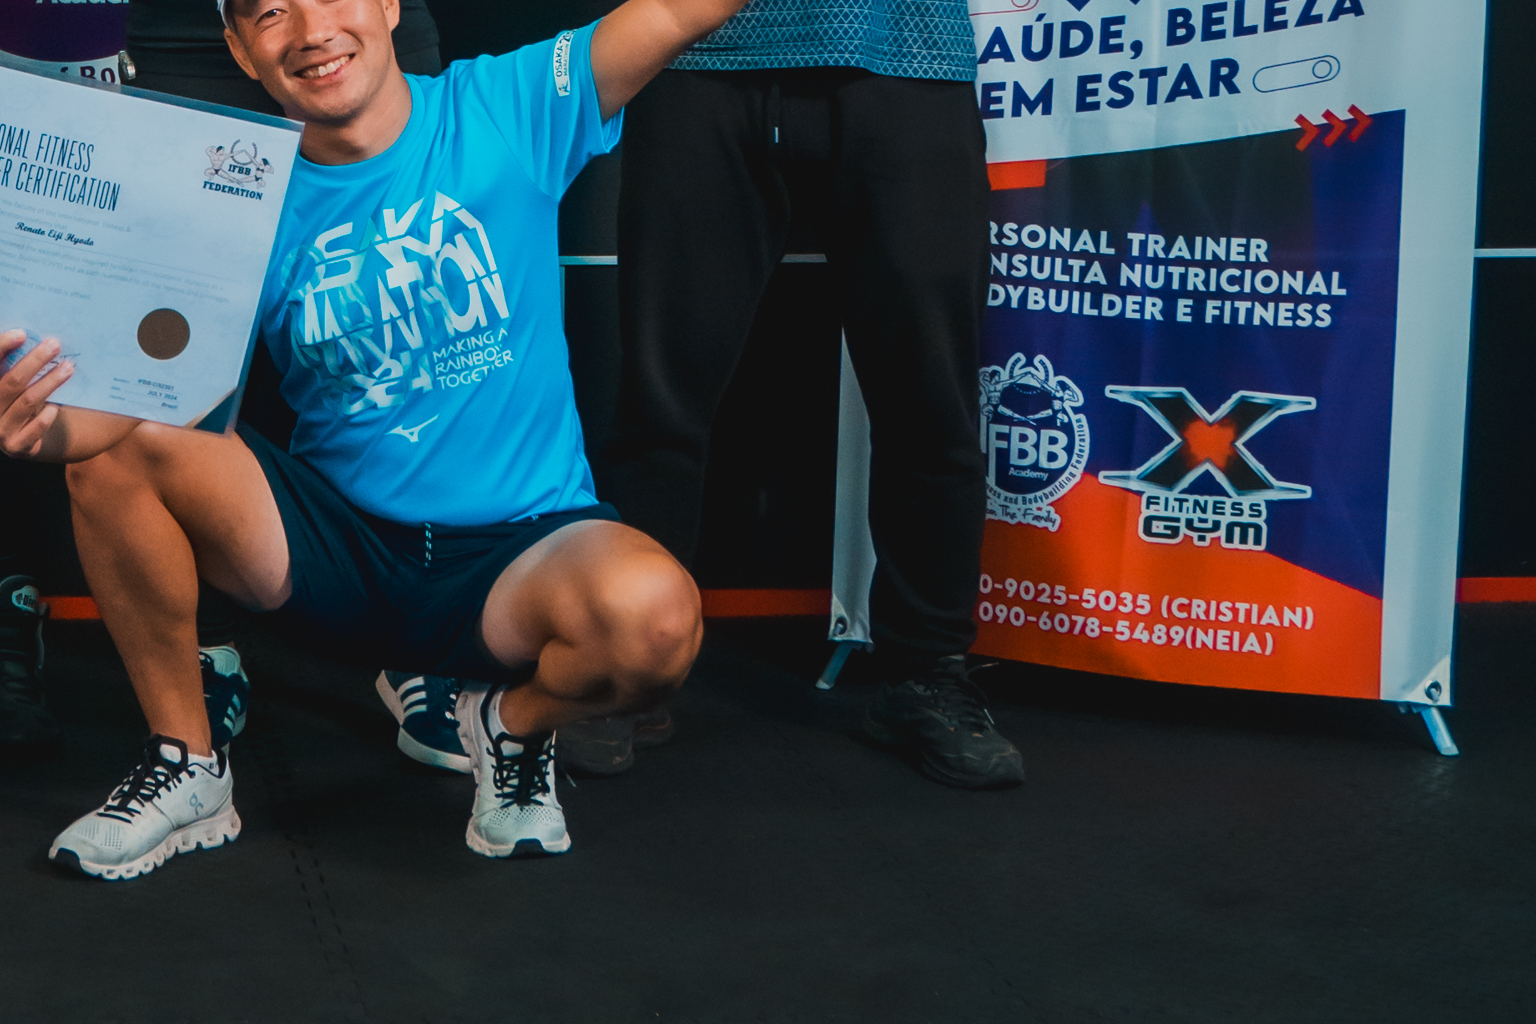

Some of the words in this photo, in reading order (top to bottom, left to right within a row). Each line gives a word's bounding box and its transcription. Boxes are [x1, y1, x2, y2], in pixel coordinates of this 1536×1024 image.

[977, 13, 1143, 64] AÚDE,
[555, 44, 563, 77] OSAKA
[980, 78, 1054, 120] EM
[1075, 57, 1241, 113] ESTAR
[35, 133, 94, 173] FITNESS
[228, 164, 251, 175] IFBB
[15, 162, 121, 211] CERTIFICATION
[203, 181, 263, 200] FEDERATION
[15, 222, 46, 235] Renato
[47, 229, 63, 241] Eiji
[989, 221, 1115, 255] RSONAL
[1127, 232, 1269, 262] TRAINER
[990, 252, 1107, 285] NSULTA
[1119, 262, 1347, 296] NUTRICIONAL
[986, 283, 1164, 321] DYBUILDER
[1176, 298, 1193, 323] E
[1205, 300, 1332, 328] FITNESS
[433, 330, 494, 363] MAKING
[498, 328, 508, 342] A
[1004, 495, 1018, 504] and
[1022, 471, 1077, 505] Bodybuilding
[1071, 418, 1086, 470] Federation
[1009, 467, 1049, 481] Academy
[999, 505, 1017, 520] The
[1145, 495, 1263, 518] FITNESS
[1143, 515, 1264, 547] GYM
[979, 574, 1151, 615] 0-9025-5035
[1161, 595, 1314, 630] (CRISTIAN)
